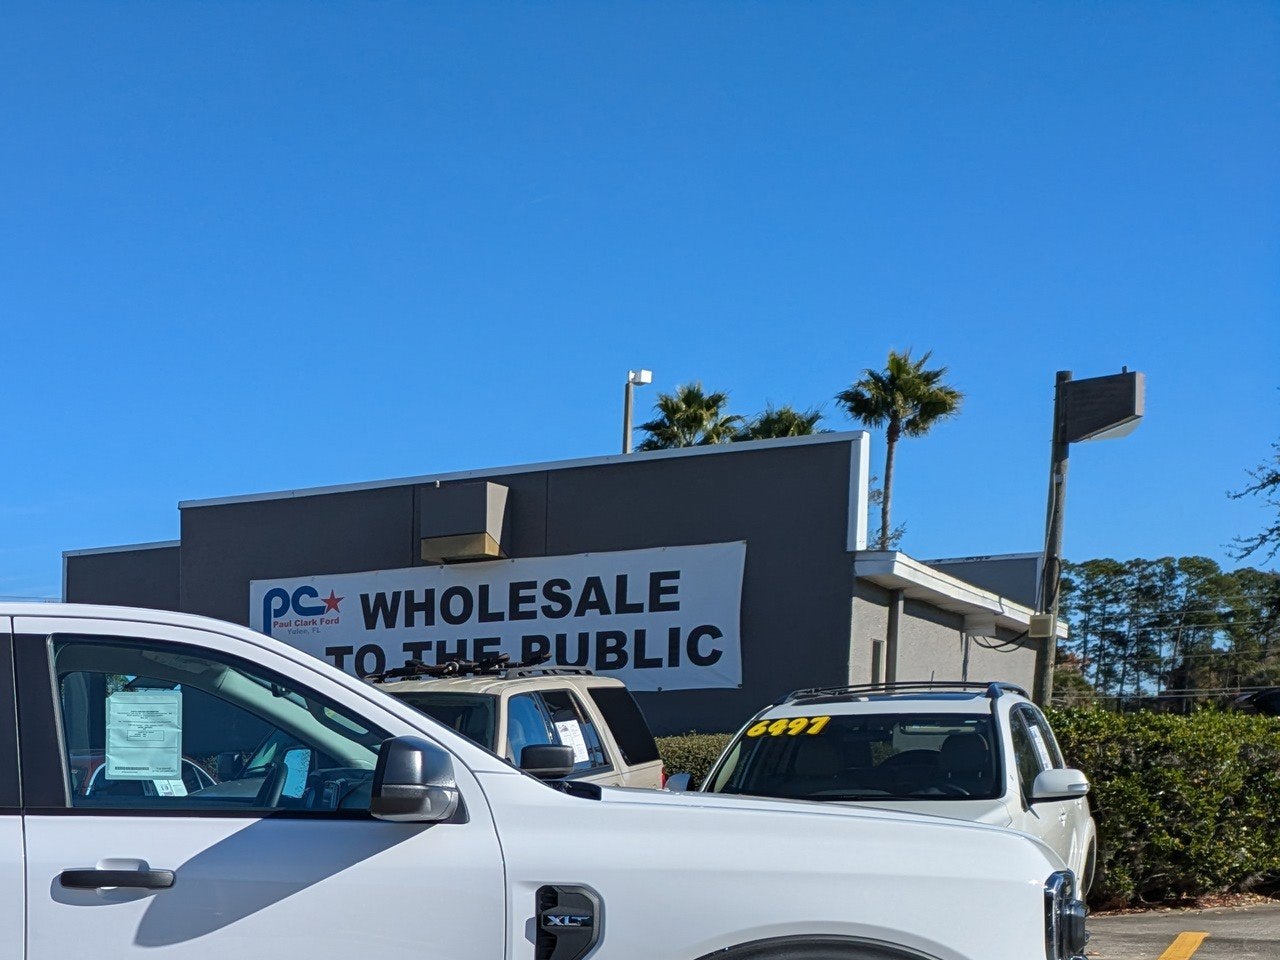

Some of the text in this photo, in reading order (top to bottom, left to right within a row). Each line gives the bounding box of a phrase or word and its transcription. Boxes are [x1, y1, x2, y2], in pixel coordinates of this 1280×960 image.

[360, 570, 681, 630] WHOLESALE
[273, 616, 340, 628] Paul Clark Ford
[325, 643, 387, 682] TO
[521, 624, 724, 672] PUBLIC
[547, 915, 590, 926] XLT
